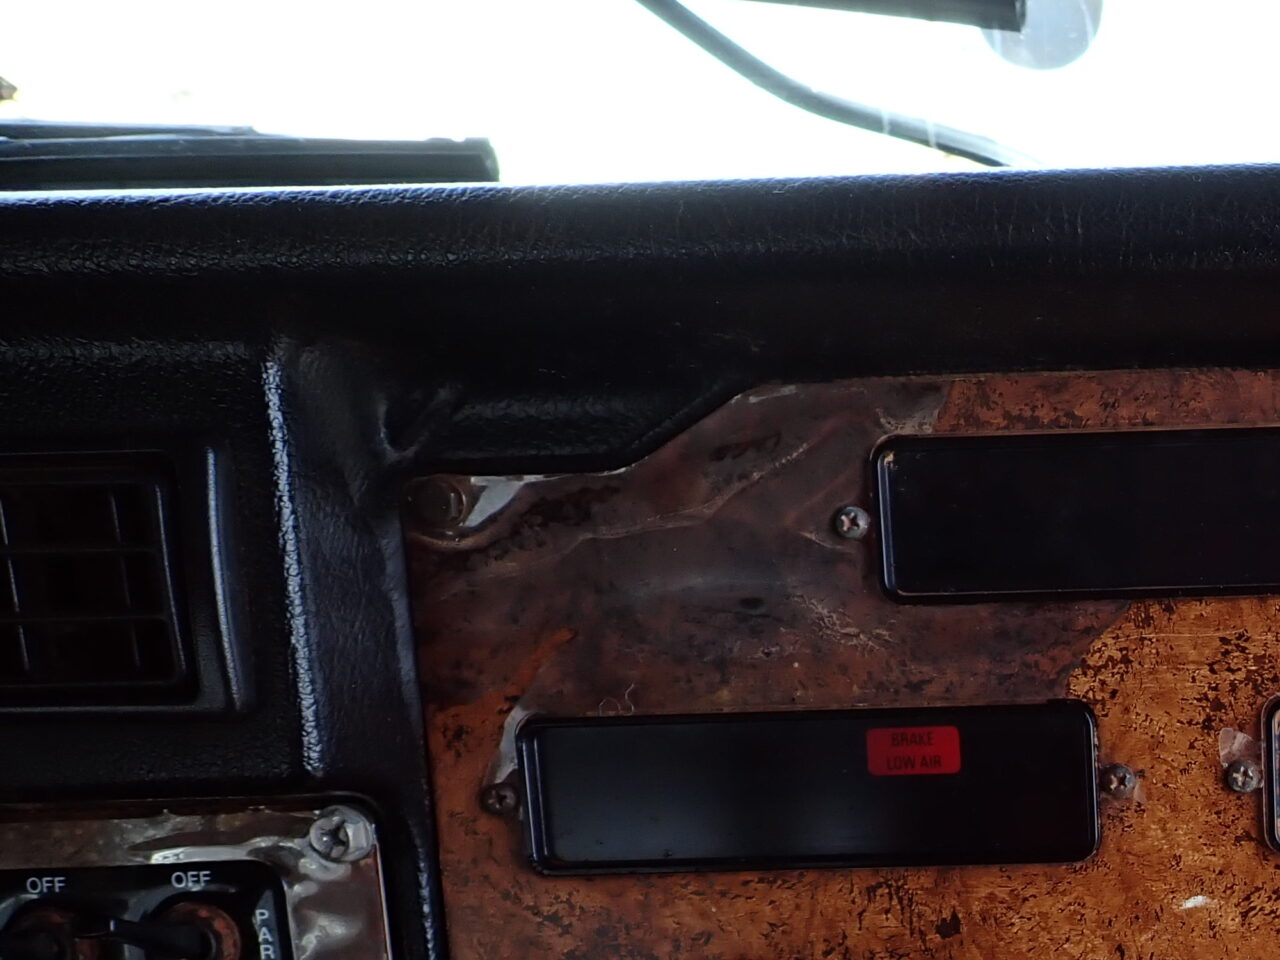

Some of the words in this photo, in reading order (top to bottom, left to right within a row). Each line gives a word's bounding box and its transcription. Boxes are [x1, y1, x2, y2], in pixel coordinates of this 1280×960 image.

[891, 731, 934, 747] BRAKE
[888, 756, 916, 770] LOW
[921, 754, 942, 769] AIR
[26, 877, 66, 894] OFF
[171, 871, 212, 888] OFF
